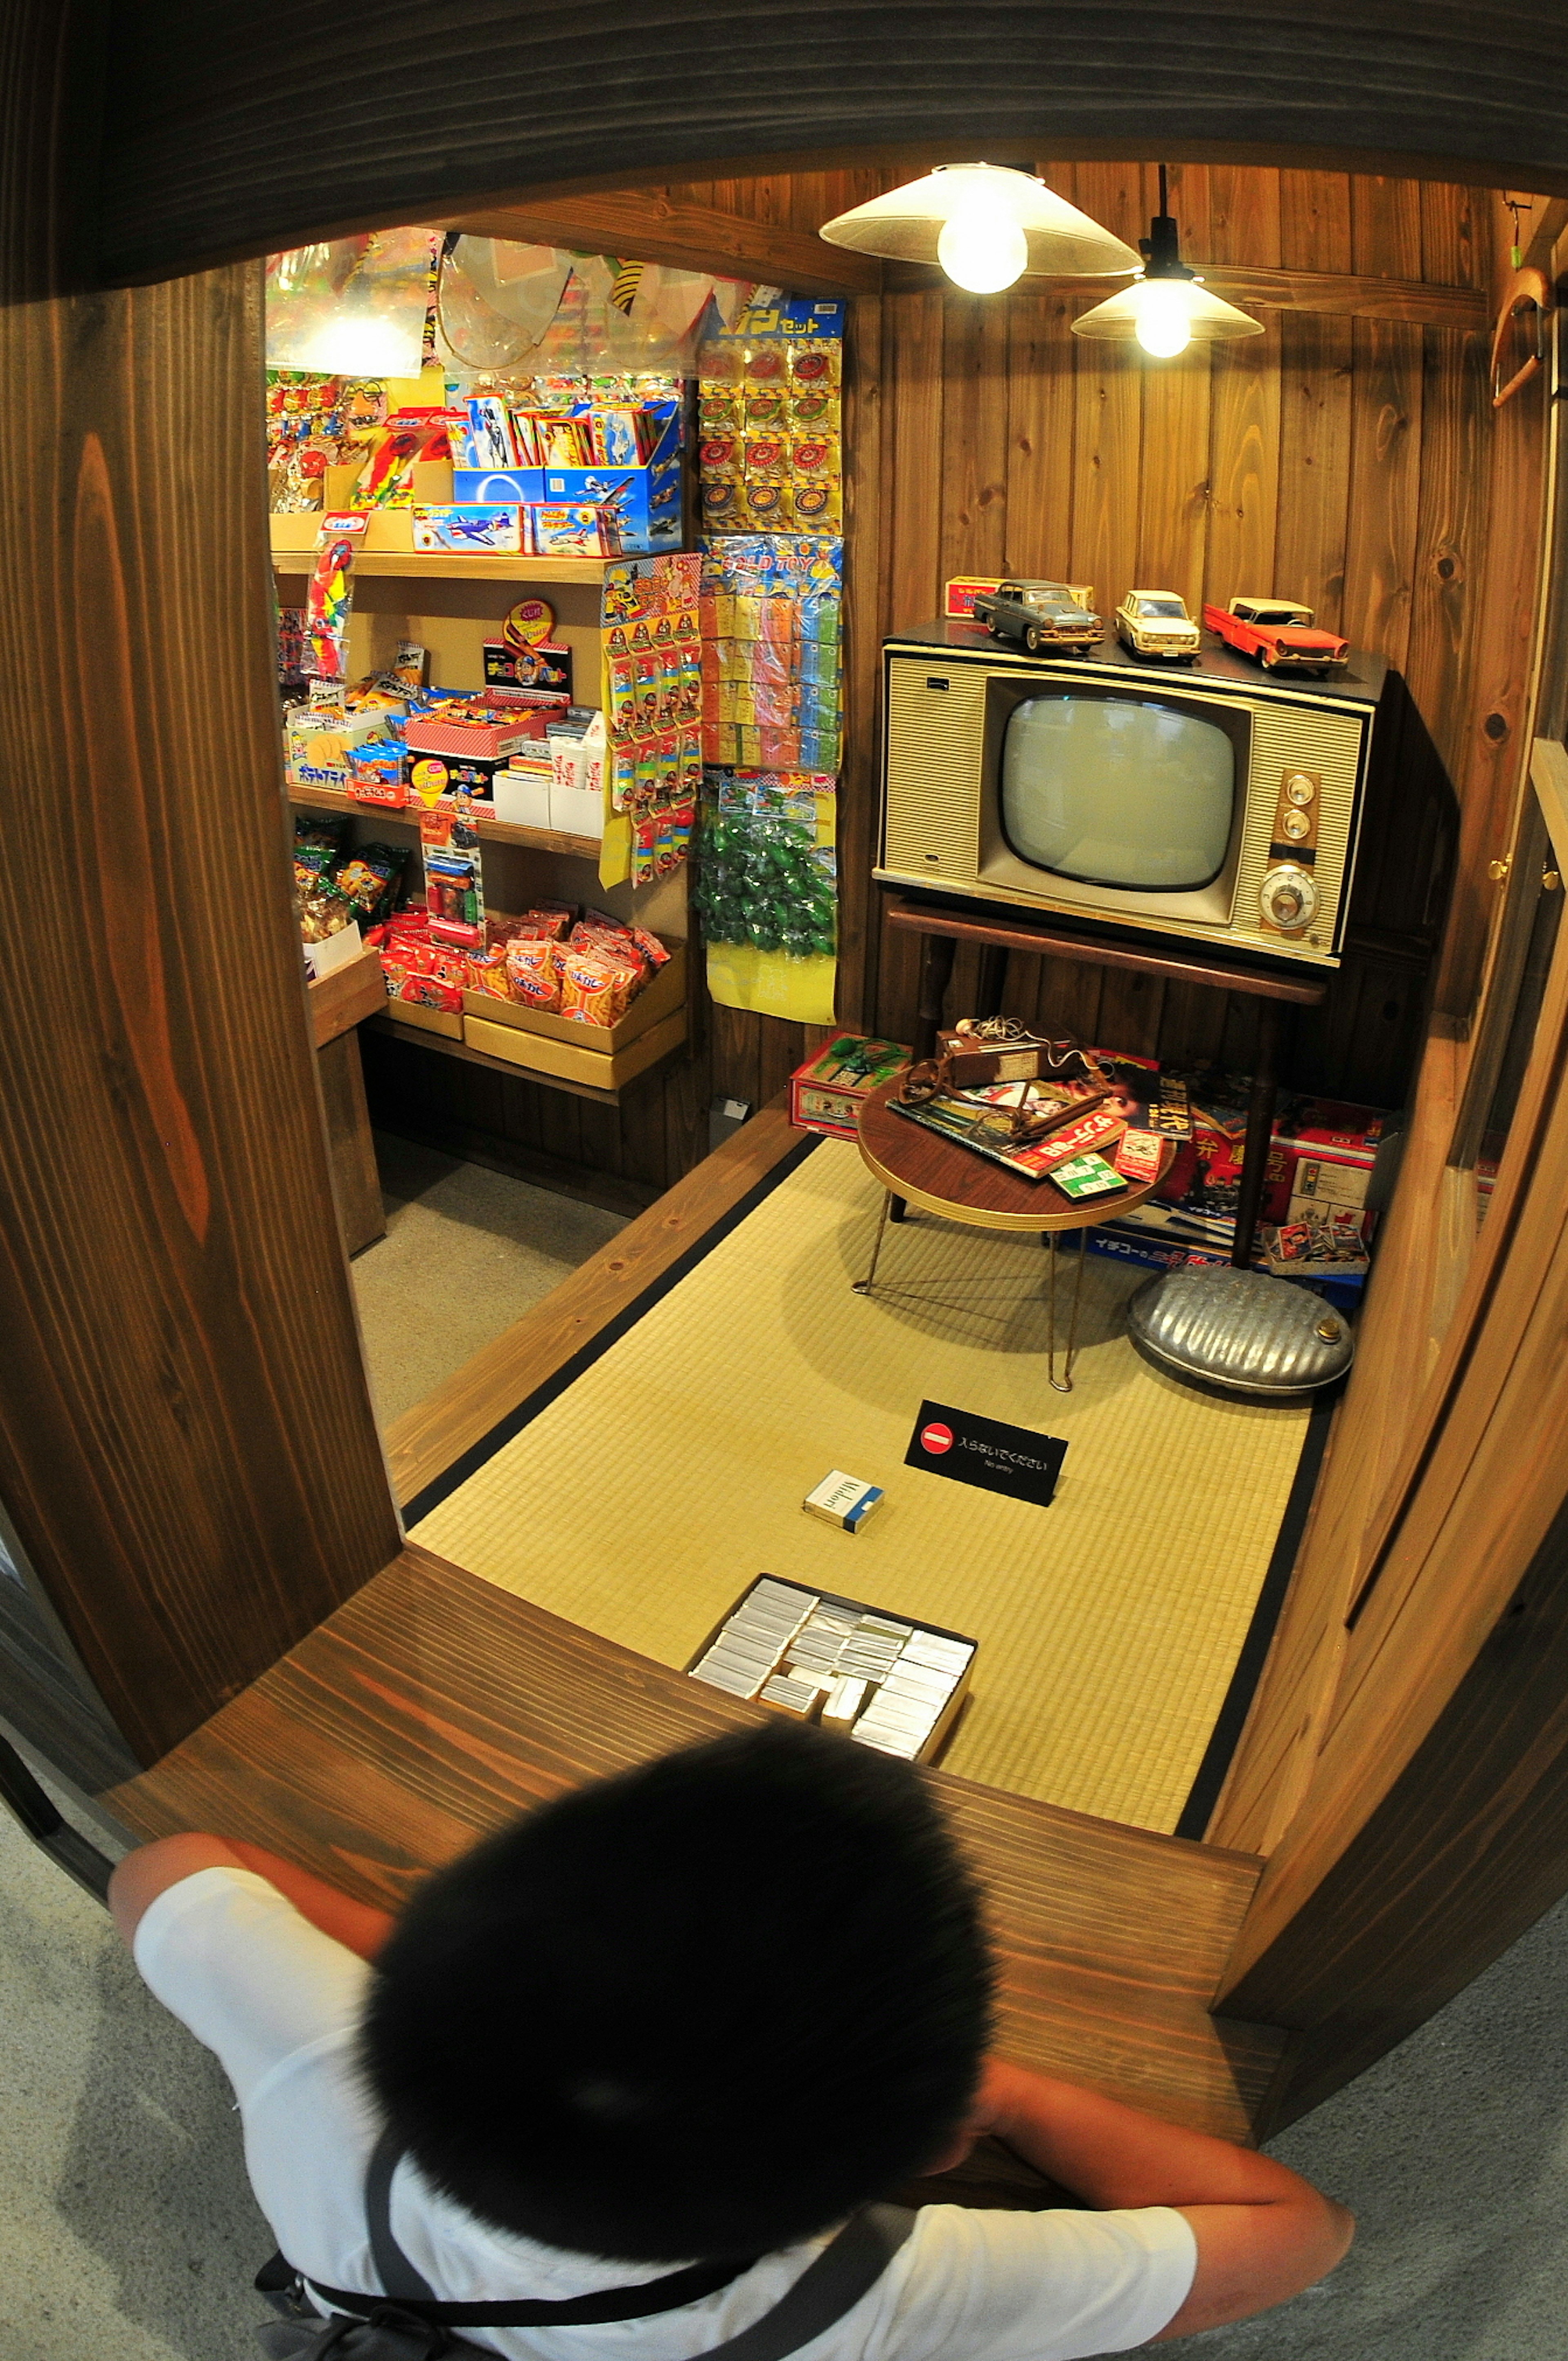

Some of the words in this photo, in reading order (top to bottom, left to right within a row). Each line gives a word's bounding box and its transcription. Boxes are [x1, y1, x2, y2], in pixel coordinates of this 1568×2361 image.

[722, 555, 772, 571] GOLD
[775, 556, 815, 571] TOY
[1038, 1115, 1114, 1157] サンデー毎日
[958, 1436, 1048, 1471] 入らないでください
[984, 1459, 995, 1468] No
[995, 1465, 1014, 1474] entry
[823, 1481, 860, 1509] Midori
